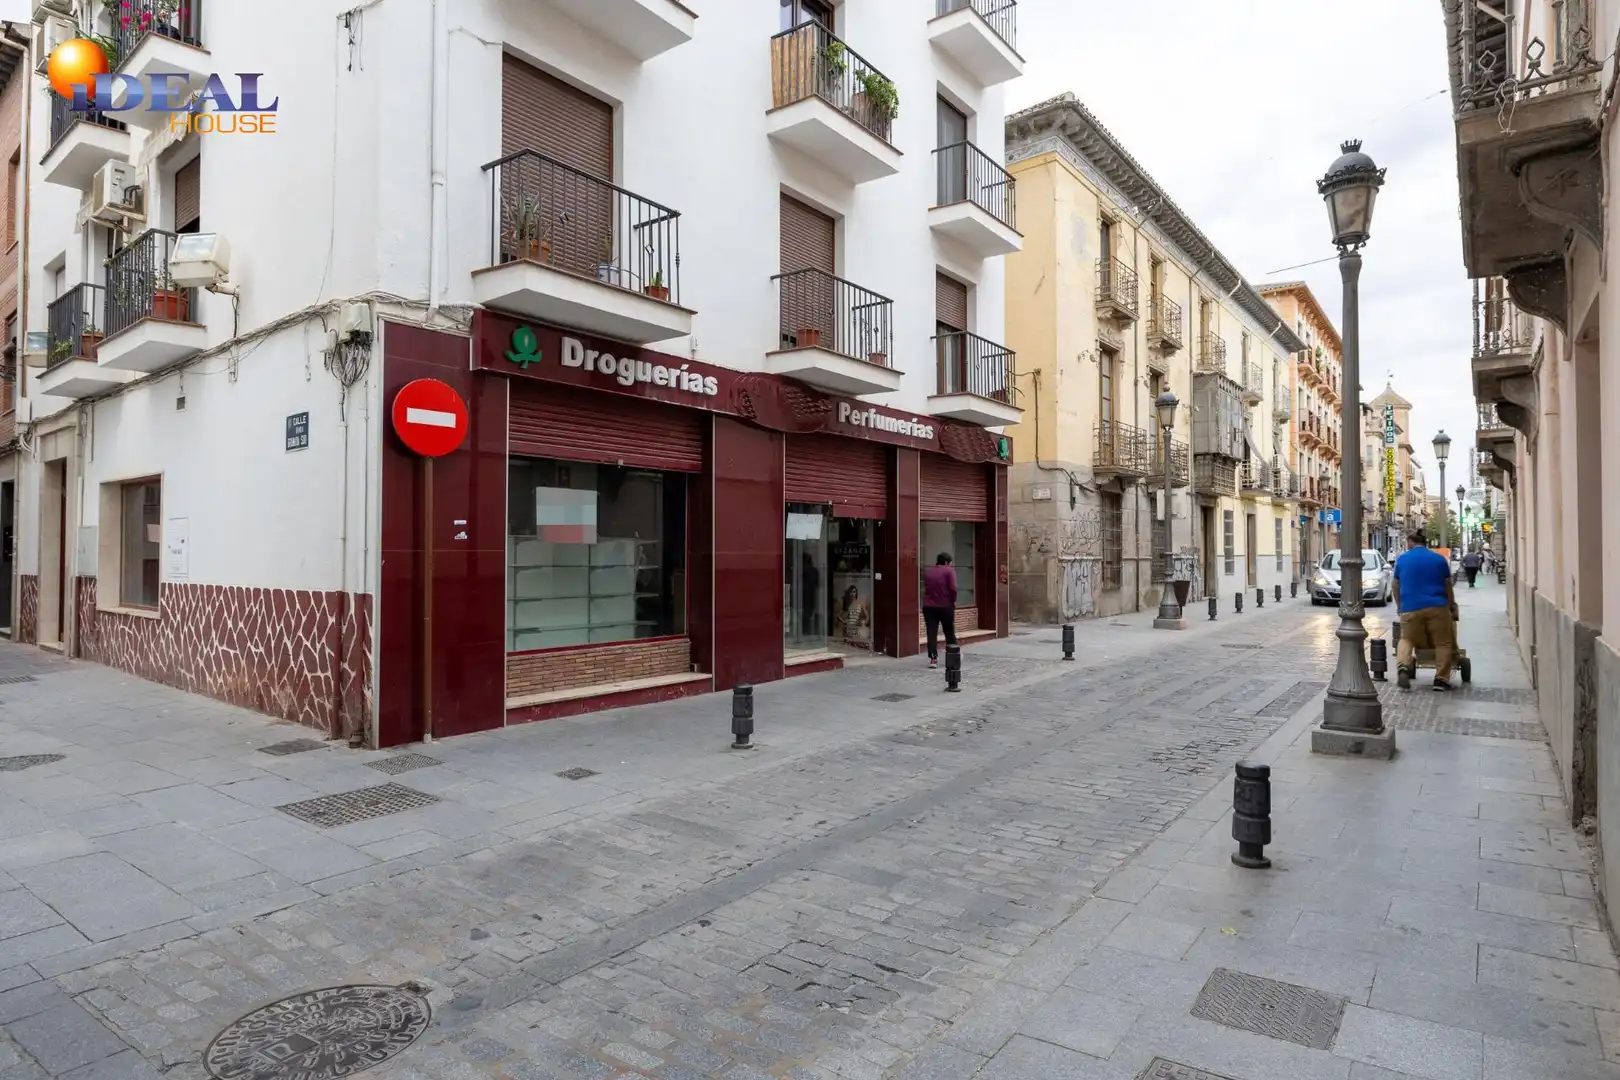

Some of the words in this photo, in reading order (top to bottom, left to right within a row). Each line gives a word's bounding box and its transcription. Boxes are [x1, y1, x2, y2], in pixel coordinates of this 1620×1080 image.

[561, 336, 718, 396] Droguerías
[293, 415, 306, 426] CALLE
[838, 401, 934, 440] Perfumerías
[1386, 404, 1395, 442] TEJIDOS
[1386, 448, 1395, 512] CONFECCIONES
